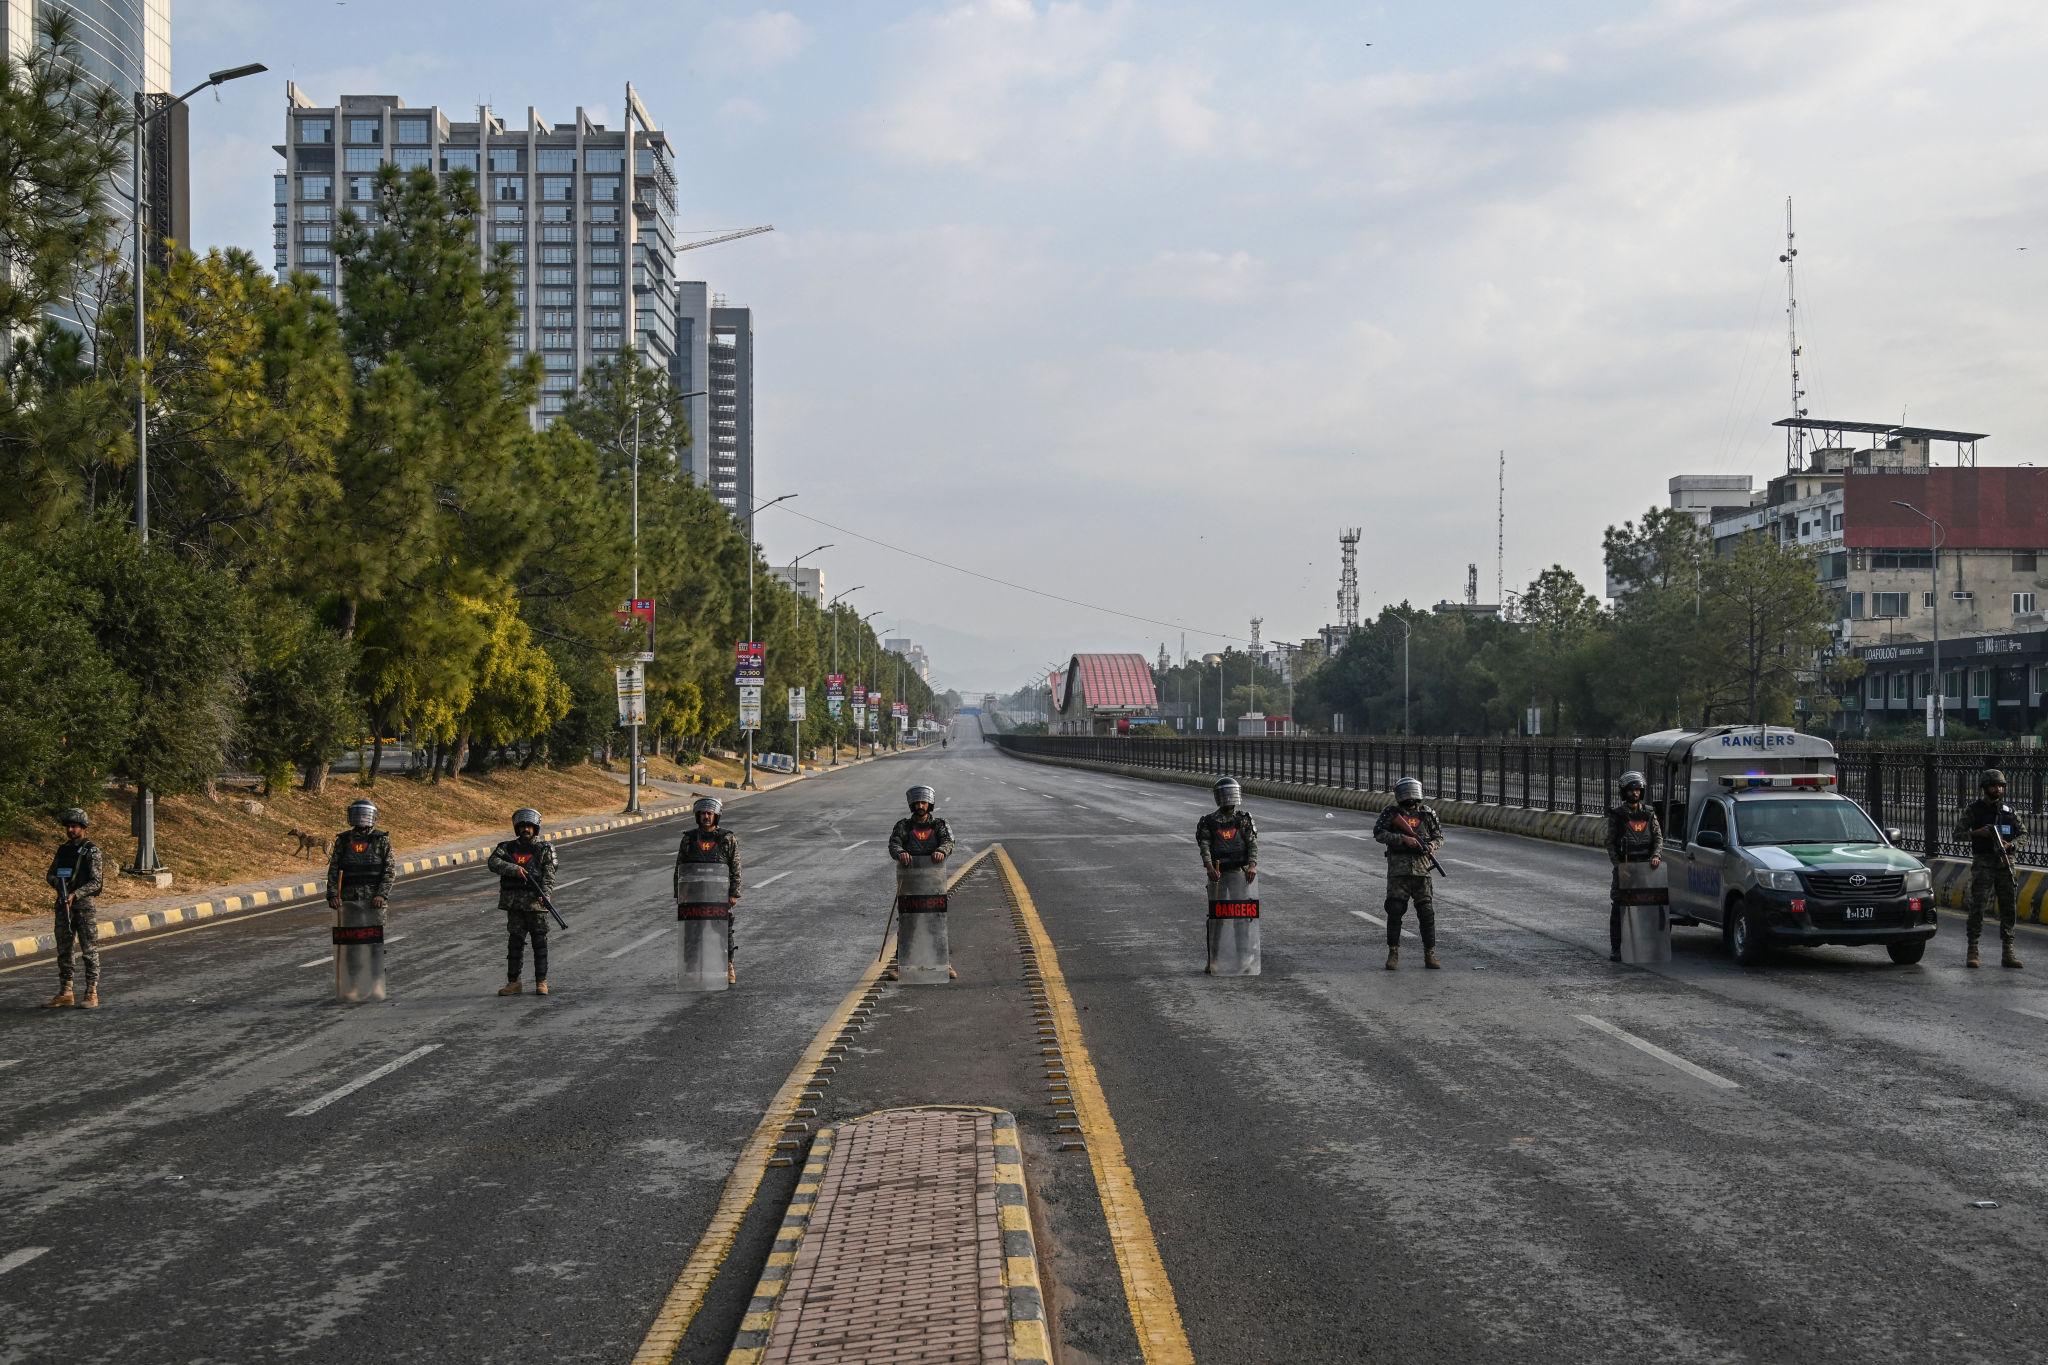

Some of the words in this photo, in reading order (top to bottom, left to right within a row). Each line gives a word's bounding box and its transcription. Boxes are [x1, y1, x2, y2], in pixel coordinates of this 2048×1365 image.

[1864, 647, 1898, 661] LOAFOLOGY
[1721, 734, 1796, 747] RANGERS
[679, 905, 728, 918] RANGERS
[1215, 903, 1257, 917] RANGERS
[1856, 907, 1874, 919] 1347
